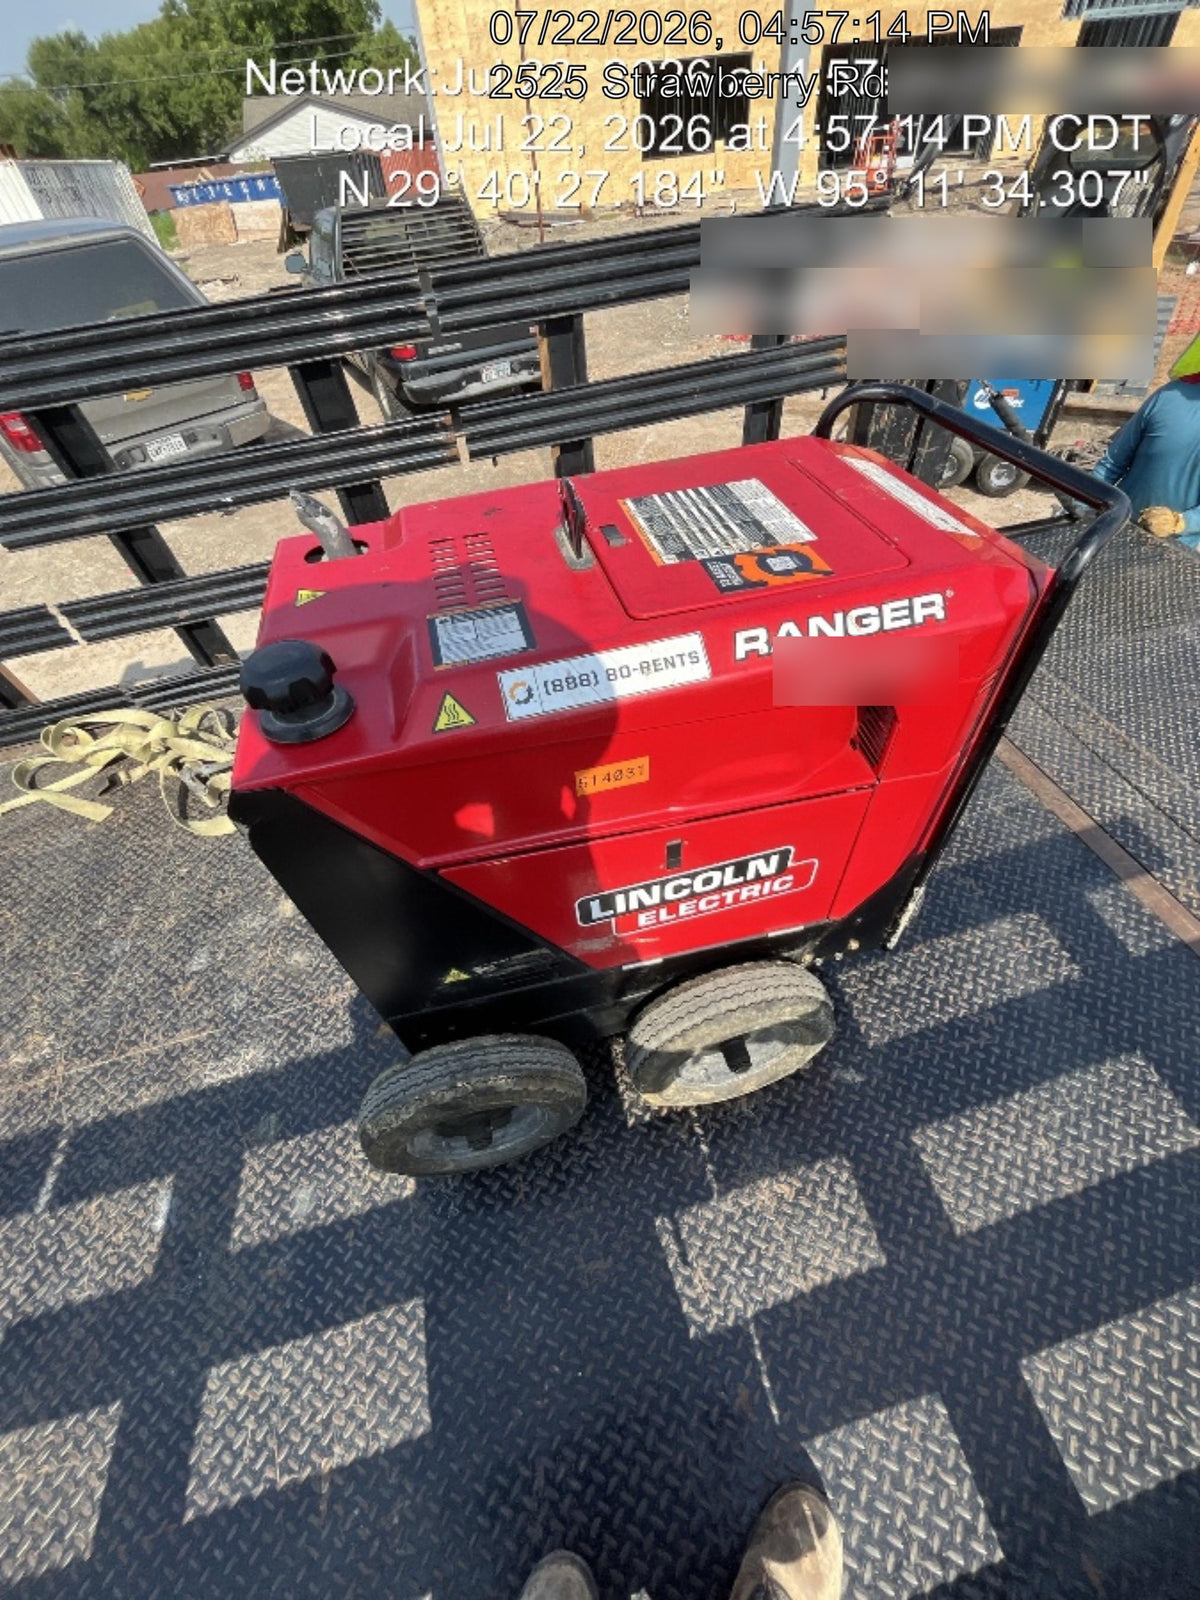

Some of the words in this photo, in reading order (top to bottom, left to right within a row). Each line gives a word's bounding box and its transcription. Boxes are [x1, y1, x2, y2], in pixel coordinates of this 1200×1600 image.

[543, 671, 600, 697] (888)
[590, 853, 780, 921] LINCOLN
[637, 875, 795, 928] ELECTRIC
